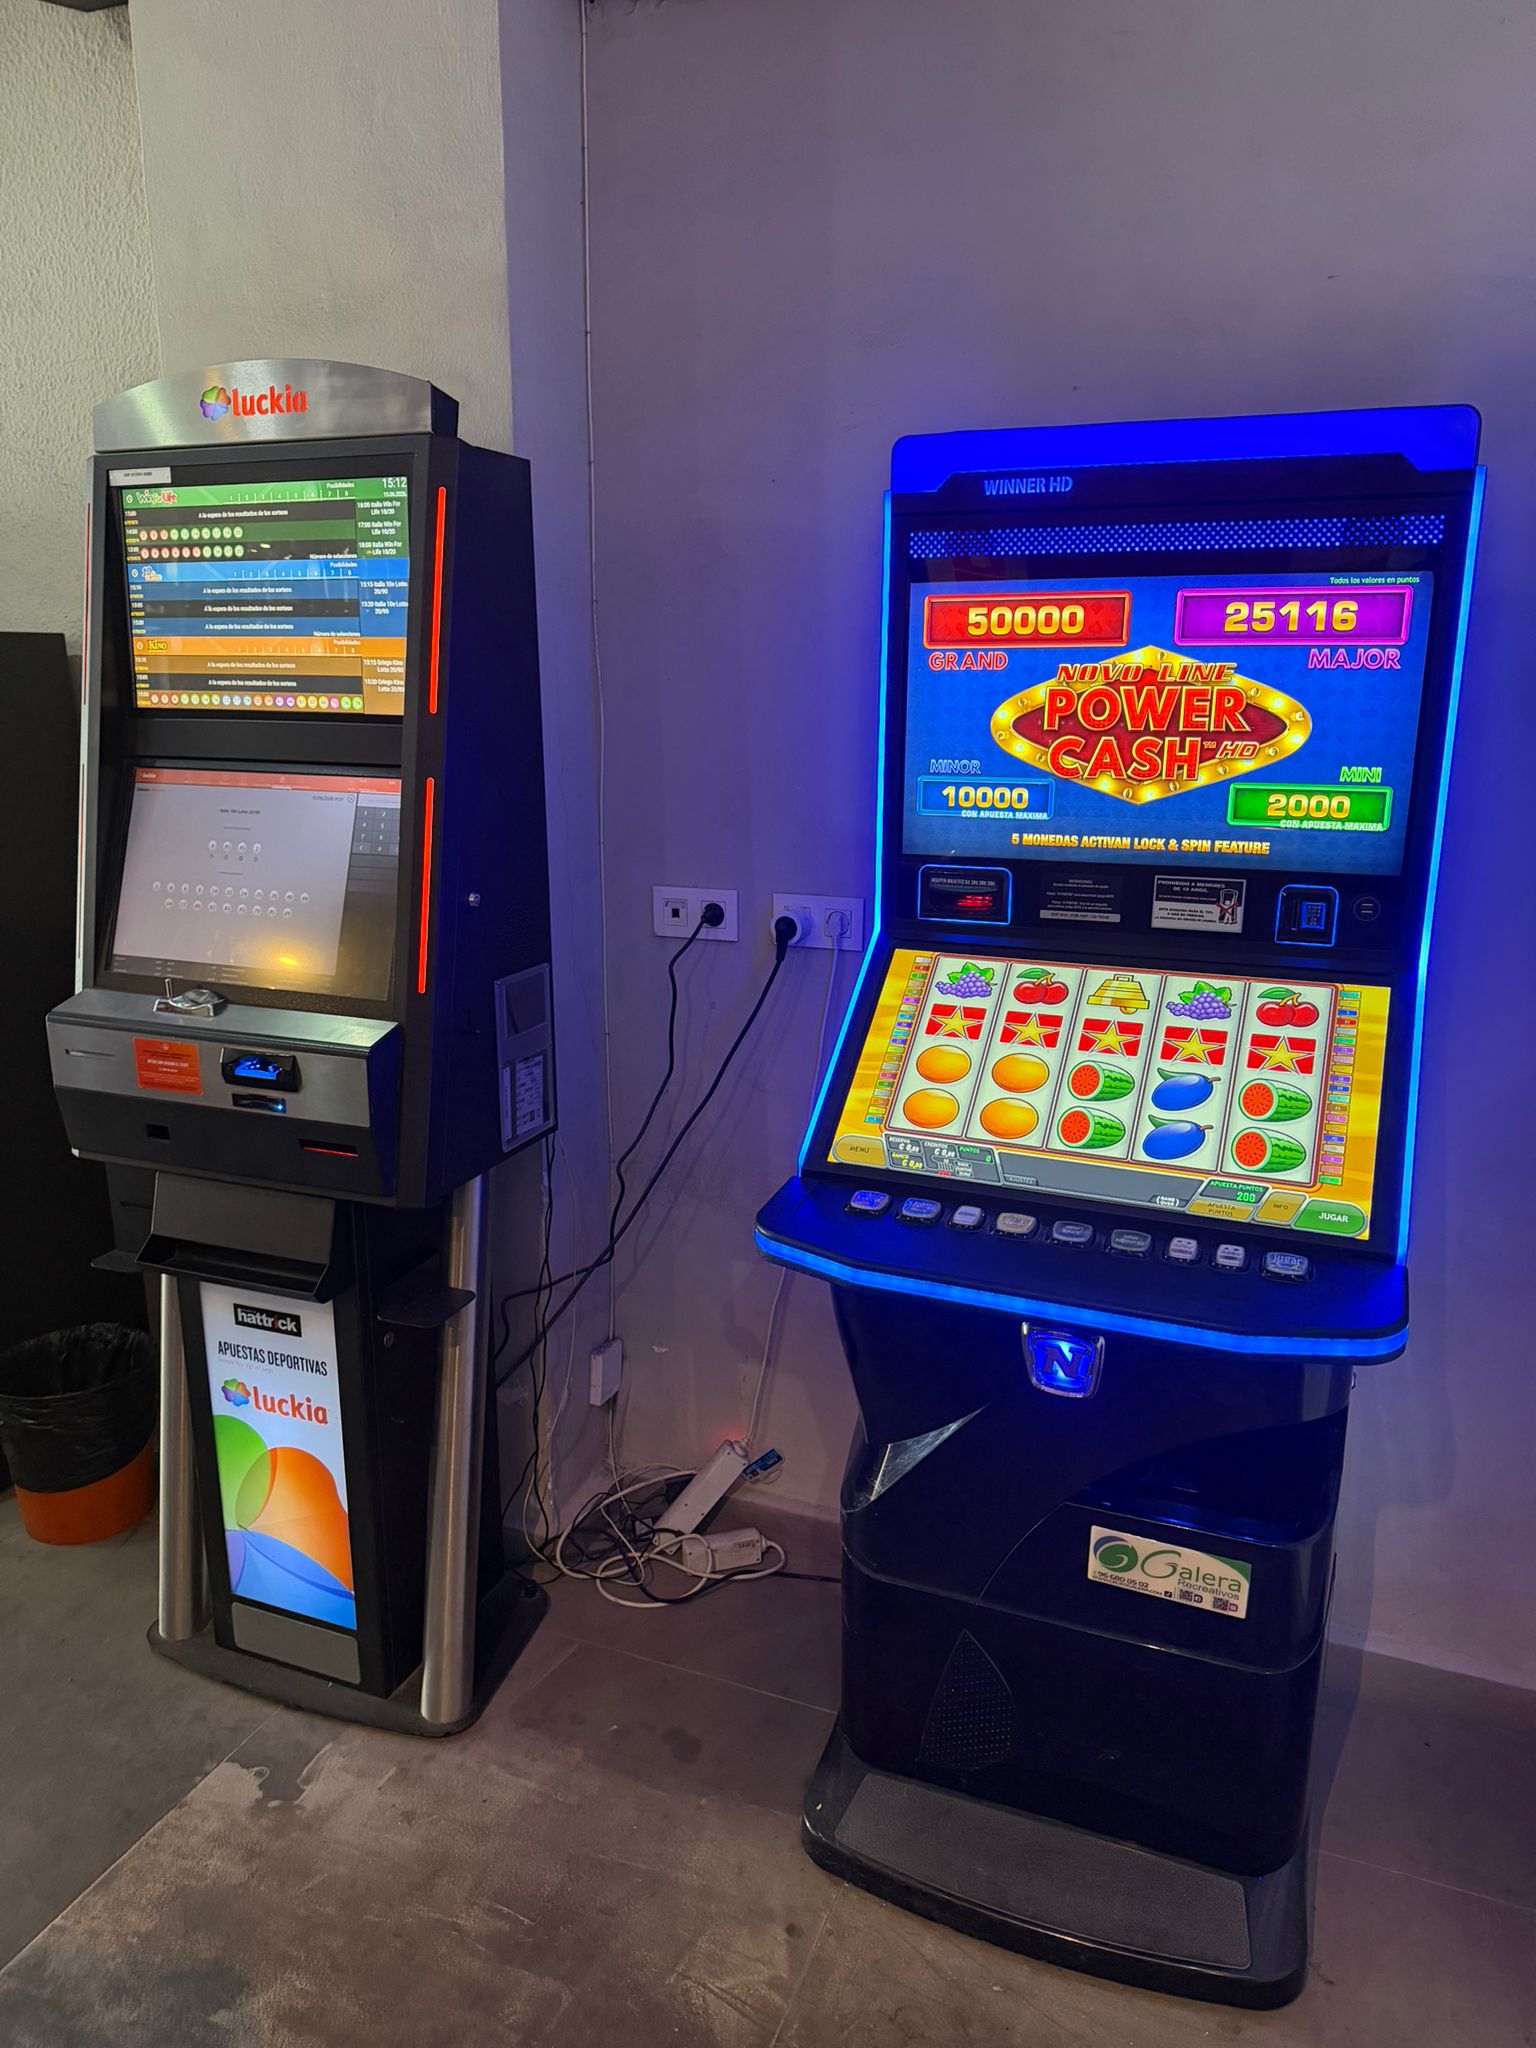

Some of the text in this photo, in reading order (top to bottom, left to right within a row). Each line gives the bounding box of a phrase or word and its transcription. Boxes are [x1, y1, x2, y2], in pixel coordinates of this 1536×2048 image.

[232, 385, 308, 418] luckia
[382, 477, 407, 488] 15:12
[984, 476, 1073, 496] WINNER HD
[1361, 576, 1385, 584] valores
[1396, 576, 1420, 584] puntos
[967, 605, 1085, 636] 50000
[1223, 600, 1359, 632] 25116
[929, 651, 1008, 671] GRAND
[1307, 648, 1401, 670] MAJOR
[1056, 662, 1237, 683] NOVO LINE
[1043, 685, 1252, 732] POWER
[929, 759, 981, 774] MINOR
[1047, 735, 1201, 781] CASH
[1216, 741, 1260, 759] HD
[1339, 766, 1382, 783] MINI
[941, 786, 1029, 809] 10000
[1266, 794, 1351, 819] 2000
[961, 809, 1048, 820] CON APUESTA MAXIMA
[1280, 819, 1383, 832] CON APUESTA MAXIMA
[1011, 833, 1271, 855] 5 MONEDAS ACTIVAN LOCK & SPIN FEATURE
[849, 1145, 869, 1153] MENU
[889, 1136, 910, 1144] RESERVA
[959, 1146, 980, 1154] PUNTOS
[985, 1155, 991, 1163] 0
[1210, 1180, 1264, 1192] APUESTA PUNTOS
[1208, 1202, 1236, 1210] APUESTA
[1236, 1191, 1256, 1202] 200
[1208, 1208, 1233, 1216] PUNTOS
[1318, 1212, 1349, 1223] JUGAR
[237, 1308, 298, 1333] hattrick
[218, 1341, 265, 1364] APUESTAS
[268, 1350, 328, 1376] DEPORTIVAS
[1043, 1347, 1083, 1378] N
[252, 1386, 328, 1425] luckia
[1098, 1571, 1109, 1579] 96
[1127, 1578, 1137, 1586] 05
[1140, 1549, 1242, 1593] Galera
[1177, 1579, 1240, 1601] Recreativos
